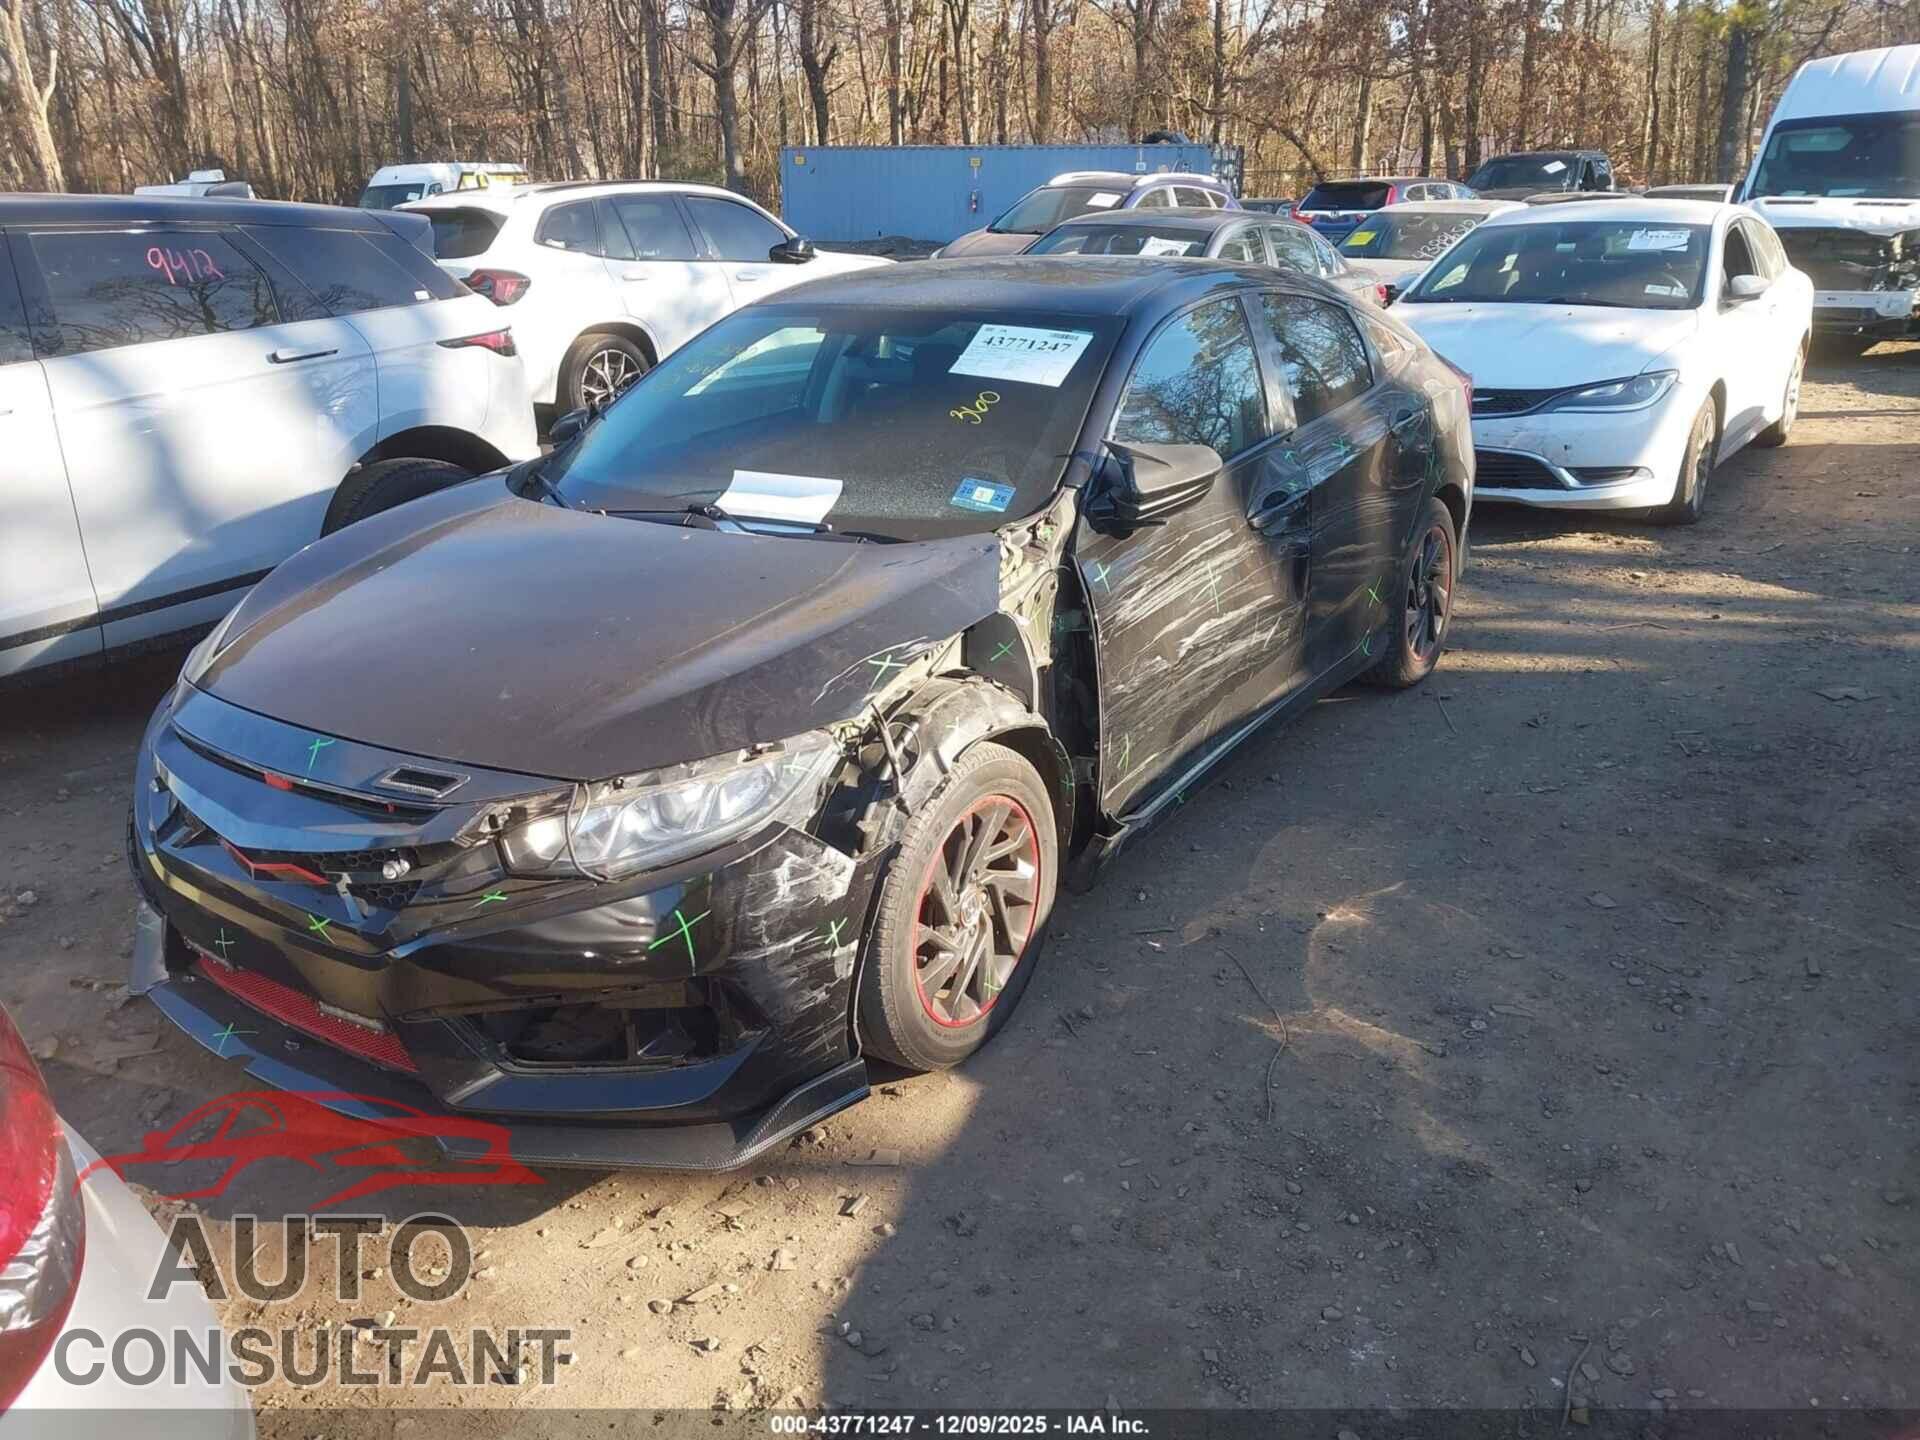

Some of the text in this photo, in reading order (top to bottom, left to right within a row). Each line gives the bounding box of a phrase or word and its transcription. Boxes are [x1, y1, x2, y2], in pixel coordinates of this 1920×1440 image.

[146, 247, 224, 285] 9412
[983, 336, 1072, 353] 43771247
[949, 390, 1001, 425] 360
